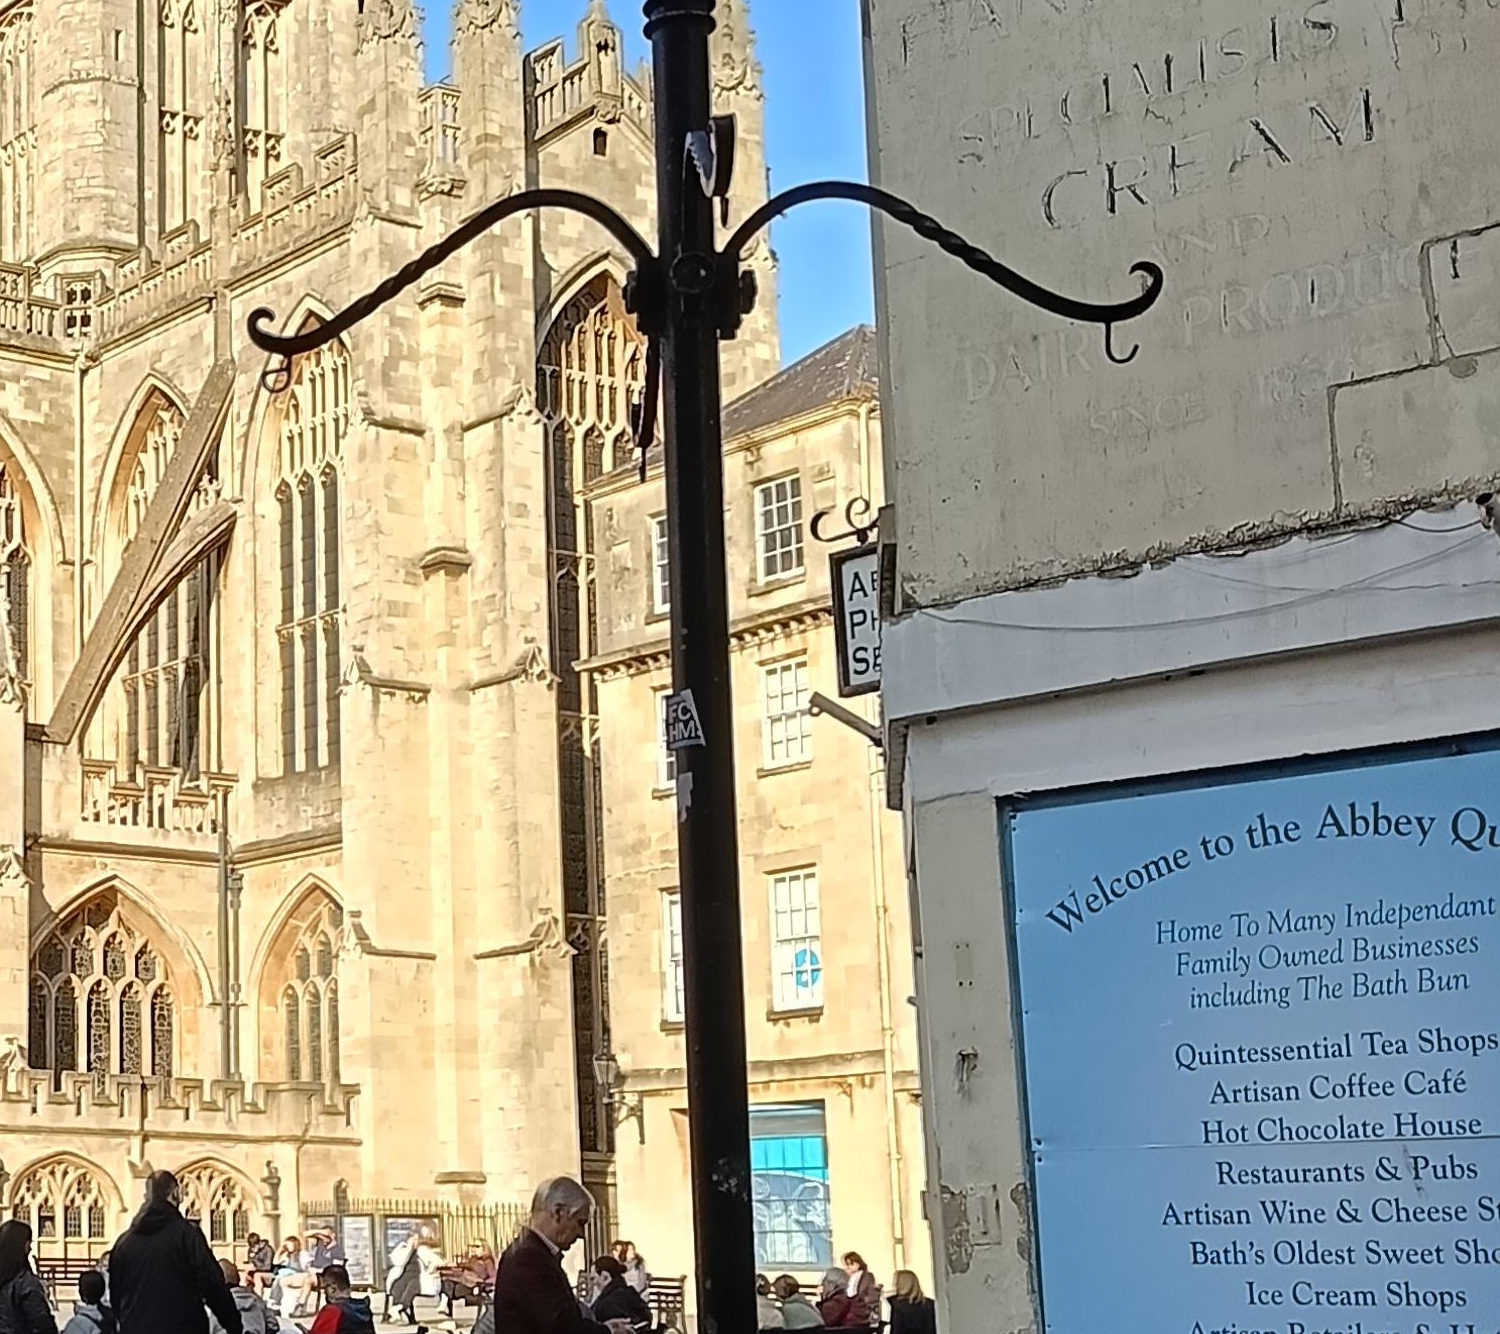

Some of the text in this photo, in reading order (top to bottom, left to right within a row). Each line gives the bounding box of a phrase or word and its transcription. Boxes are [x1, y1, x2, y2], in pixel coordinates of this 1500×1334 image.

[1042, 88, 1373, 229] CREAM
[1046, 846, 1191, 934] Welcome
[1200, 834, 1235, 862] to
[1246, 813, 1302, 851] the
[1316, 801, 1436, 847] Abbey
[1156, 892, 1497, 945] Home To Many Independant
[1176, 932, 1479, 977] Family Owned Businesses
[1190, 967, 1471, 1009] including The Bath Bun
[1175, 1027, 1499, 1072] Quintessential Tea Shops
[1210, 1068, 1467, 1105] Artisan Coffee Café
[1202, 1111, 1483, 1144] Hot Chocolate House
[1216, 1154, 1478, 1186] Restaurants & Pubs
[1161, 1202, 1250, 1226] Artisan
[1260, 1199, 1326, 1225] Wine
[1336, 1198, 1363, 1224] &
[1371, 1197, 1468, 1224] Cheese
[1190, 1240, 1264, 1266] Bath's
[1273, 1239, 1355, 1266] Oldest
[1365, 1239, 1445, 1265] Sweet
[1246, 1280, 1467, 1313] Ice Cream Shops
